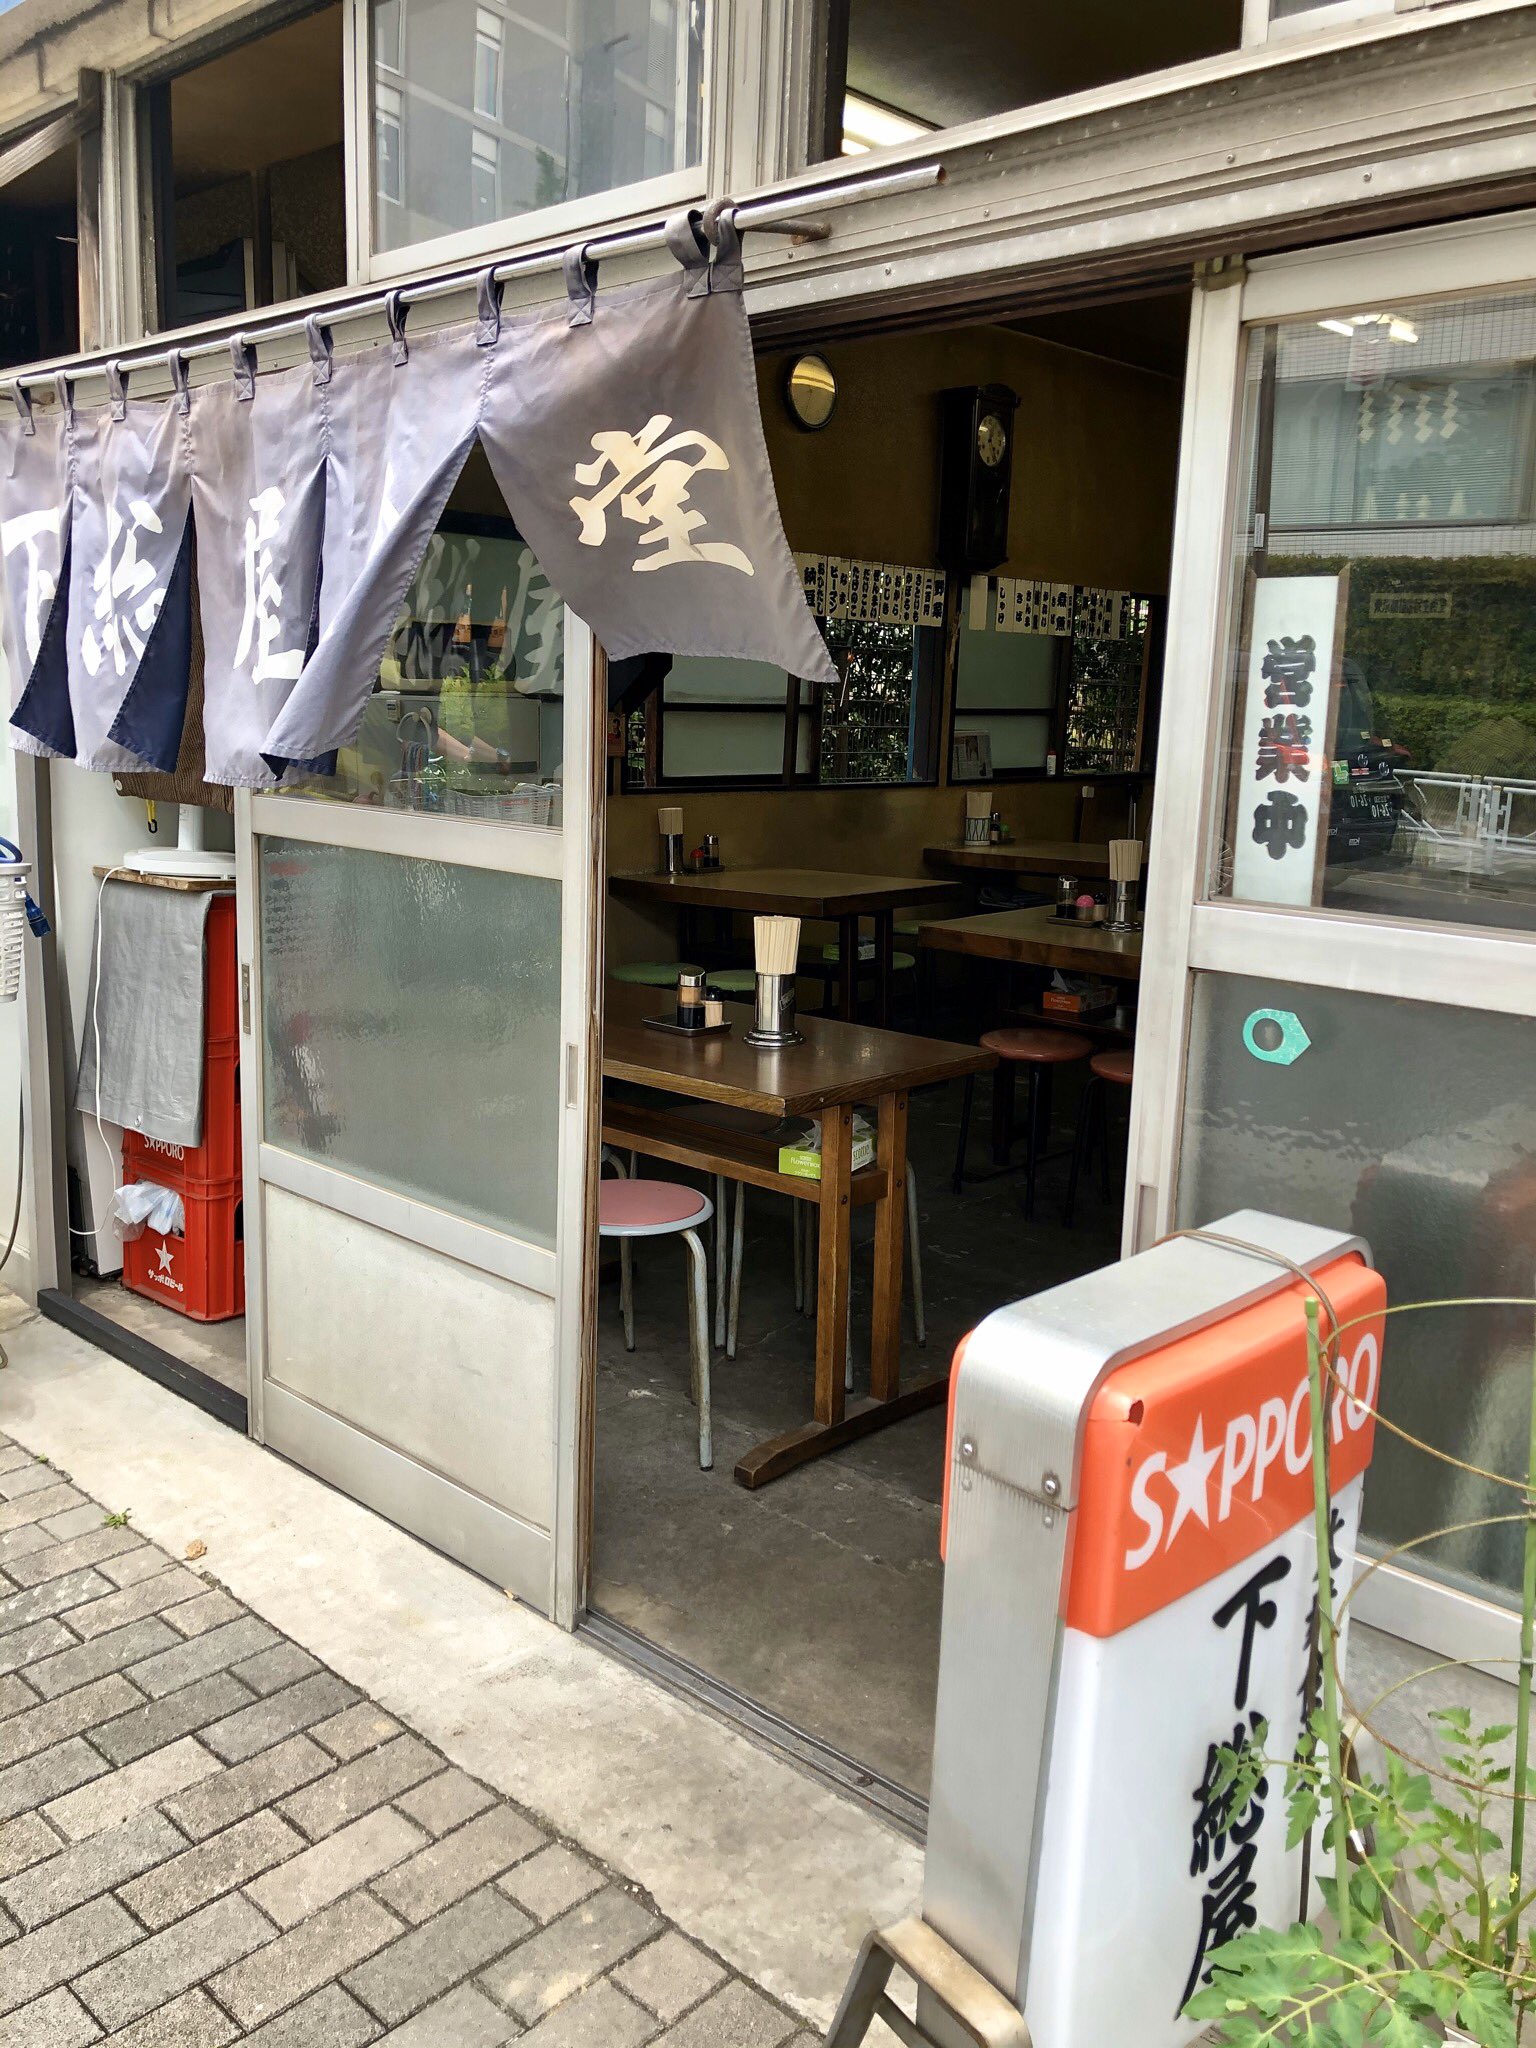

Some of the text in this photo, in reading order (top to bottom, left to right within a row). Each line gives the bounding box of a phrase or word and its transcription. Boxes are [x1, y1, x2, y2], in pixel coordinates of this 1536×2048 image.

[828, 565, 839, 614] ピーマン
[850, 565, 860, 618] たけのこ
[882, 573, 892, 616] ひじき
[891, 574, 902, 617] おから
[932, 579, 945, 619] 野菜
[997, 586, 1006, 625] しゃけ
[1253, 635, 1316, 860] 営業中
[148, 1269, 184, 1292] サッポロビール
